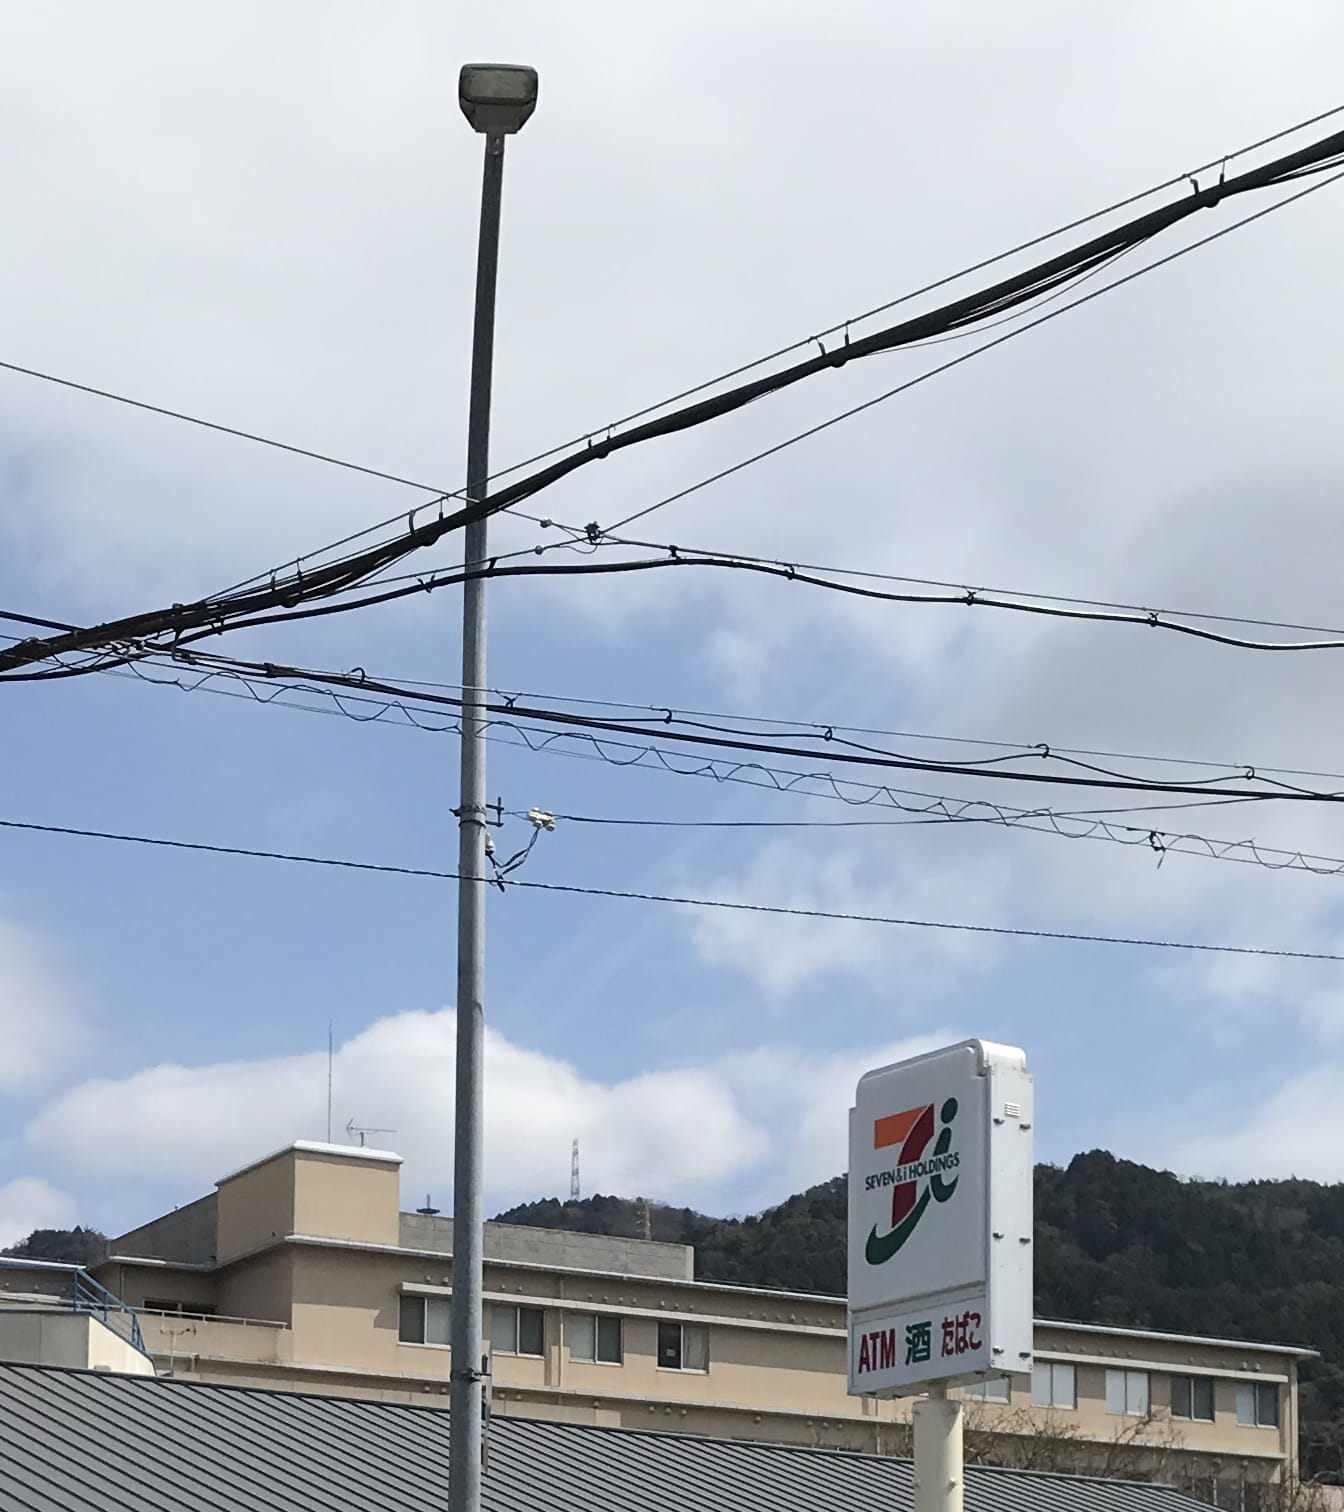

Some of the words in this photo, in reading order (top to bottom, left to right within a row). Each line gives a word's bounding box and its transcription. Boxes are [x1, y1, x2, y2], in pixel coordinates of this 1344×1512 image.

[908, 1151, 961, 1180] HOLDINGS
[858, 1327, 896, 1375] ATM
[904, 1320, 933, 1367] 酒
[940, 1309, 983, 1358] たばこ
